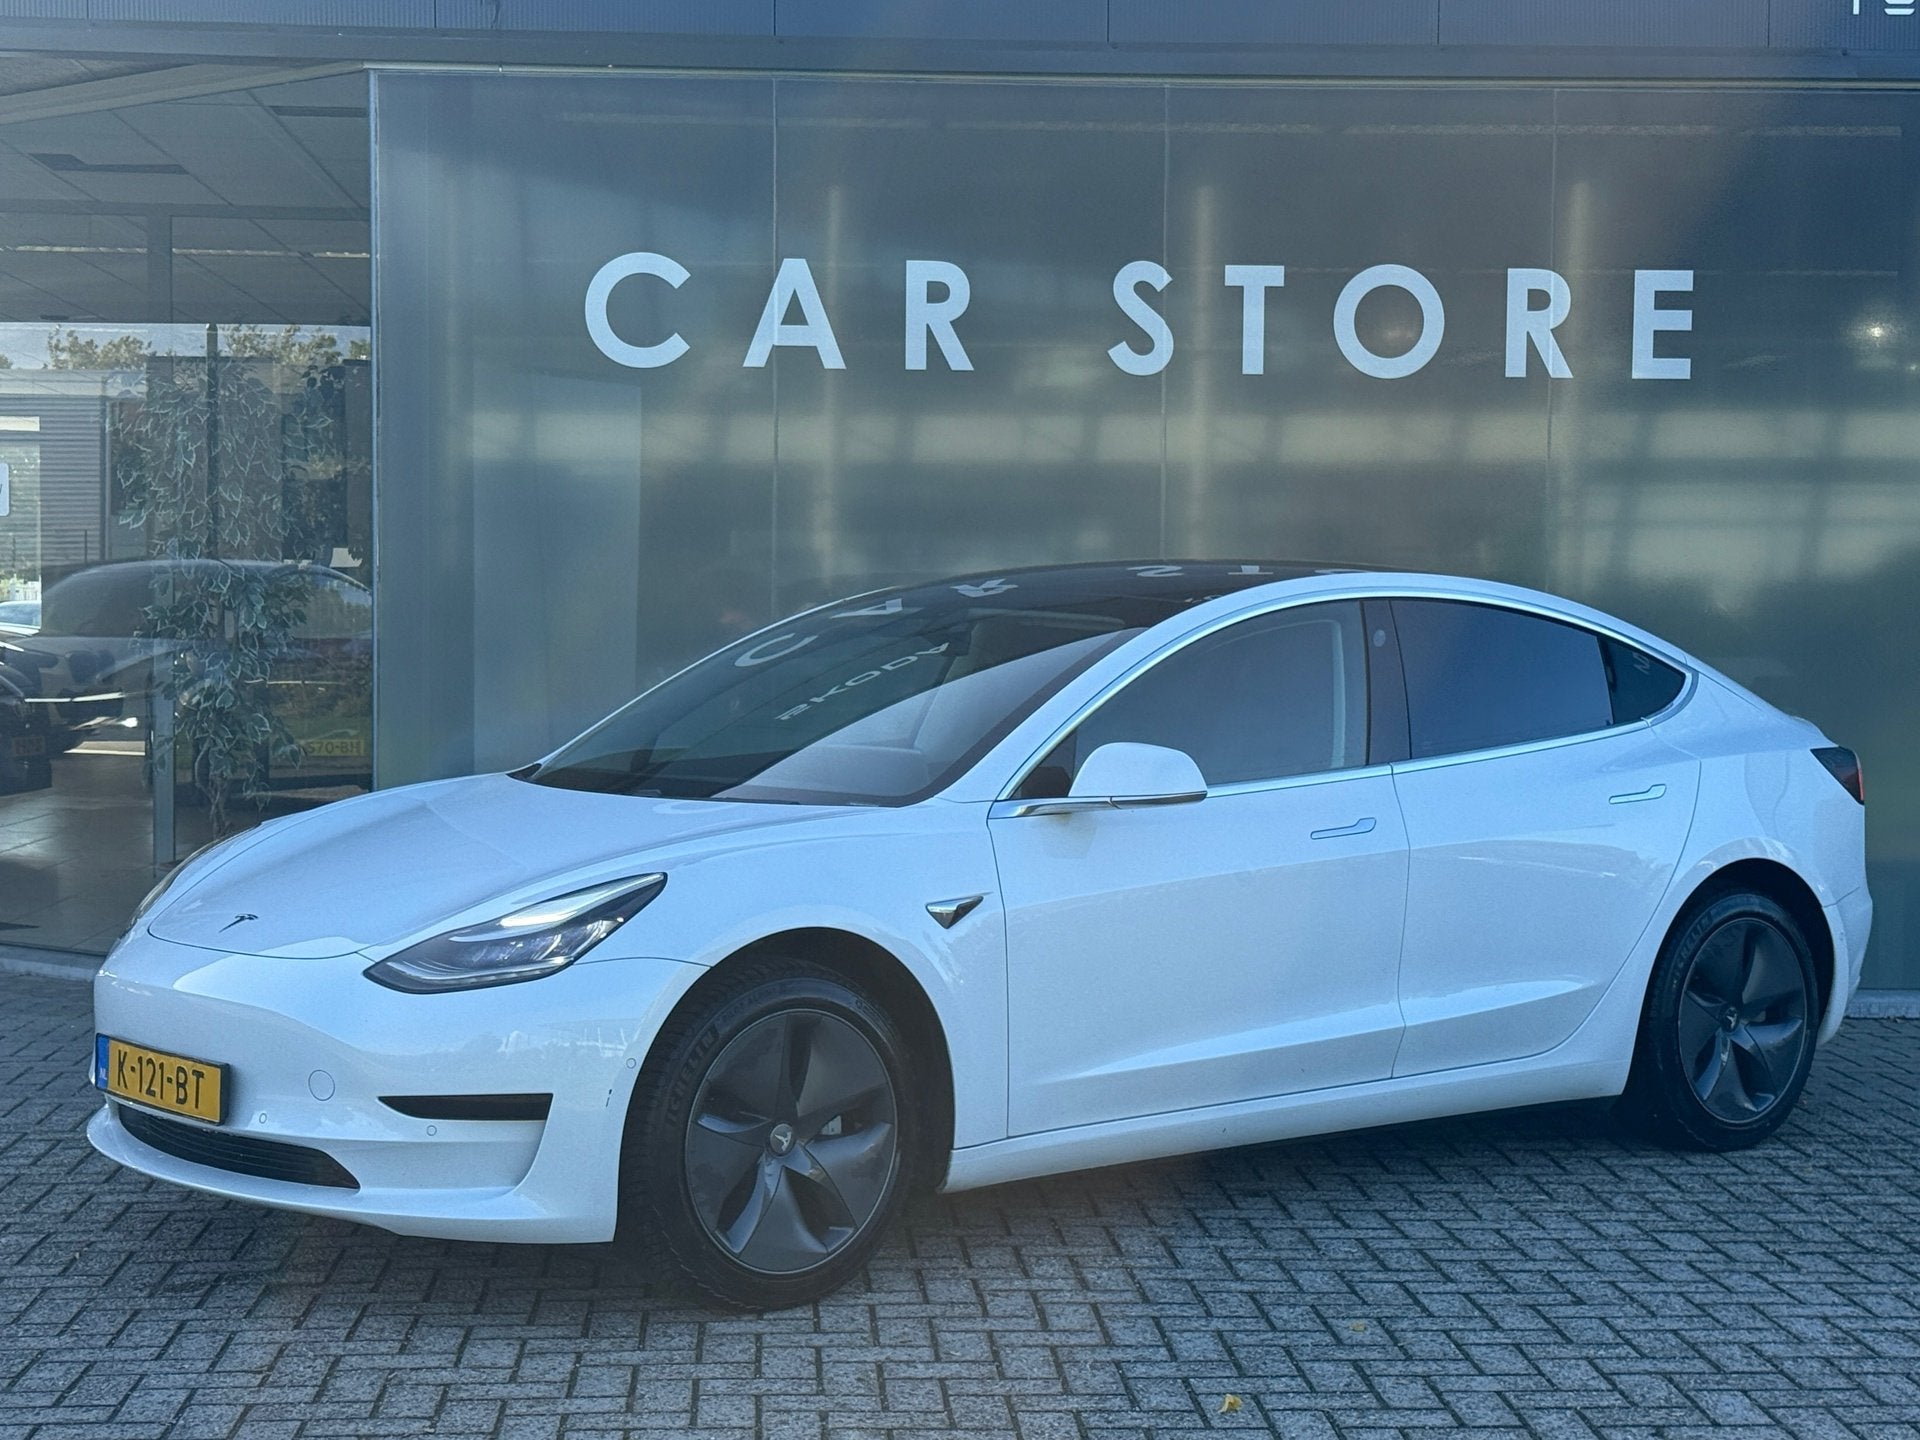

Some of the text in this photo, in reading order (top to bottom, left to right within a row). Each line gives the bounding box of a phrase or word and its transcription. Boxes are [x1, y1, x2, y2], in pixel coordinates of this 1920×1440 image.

[584, 251, 1694, 381] CAR STORE
[117, 1049, 205, 1110] K-121-BT
